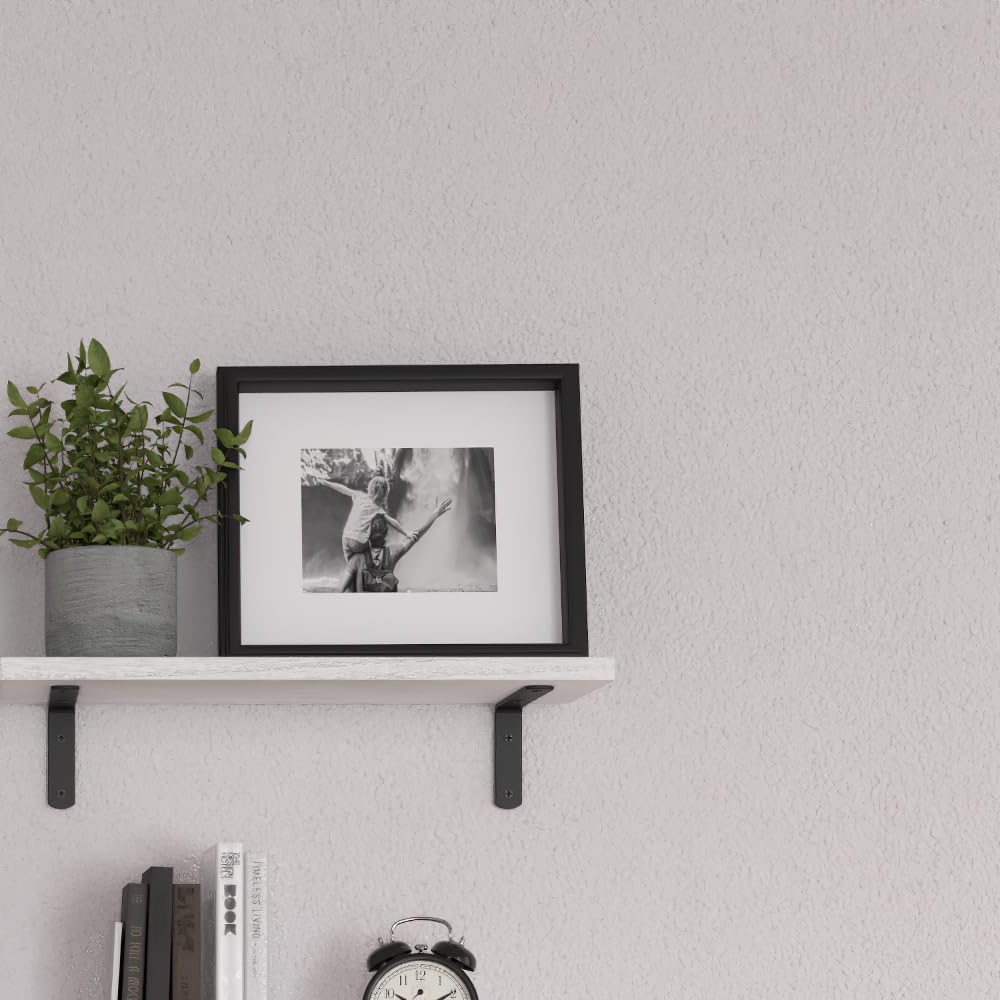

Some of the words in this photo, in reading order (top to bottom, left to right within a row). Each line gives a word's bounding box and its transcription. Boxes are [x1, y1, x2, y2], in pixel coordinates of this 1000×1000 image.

[224, 885, 236, 935] BOOK
[250, 909, 261, 939] LIVING
[399, 976, 407, 985] 11
[416, 970, 426, 981] 12
[438, 975, 442, 985] 1
[385, 989, 395, 999] 10
[451, 989, 457, 998] 2
